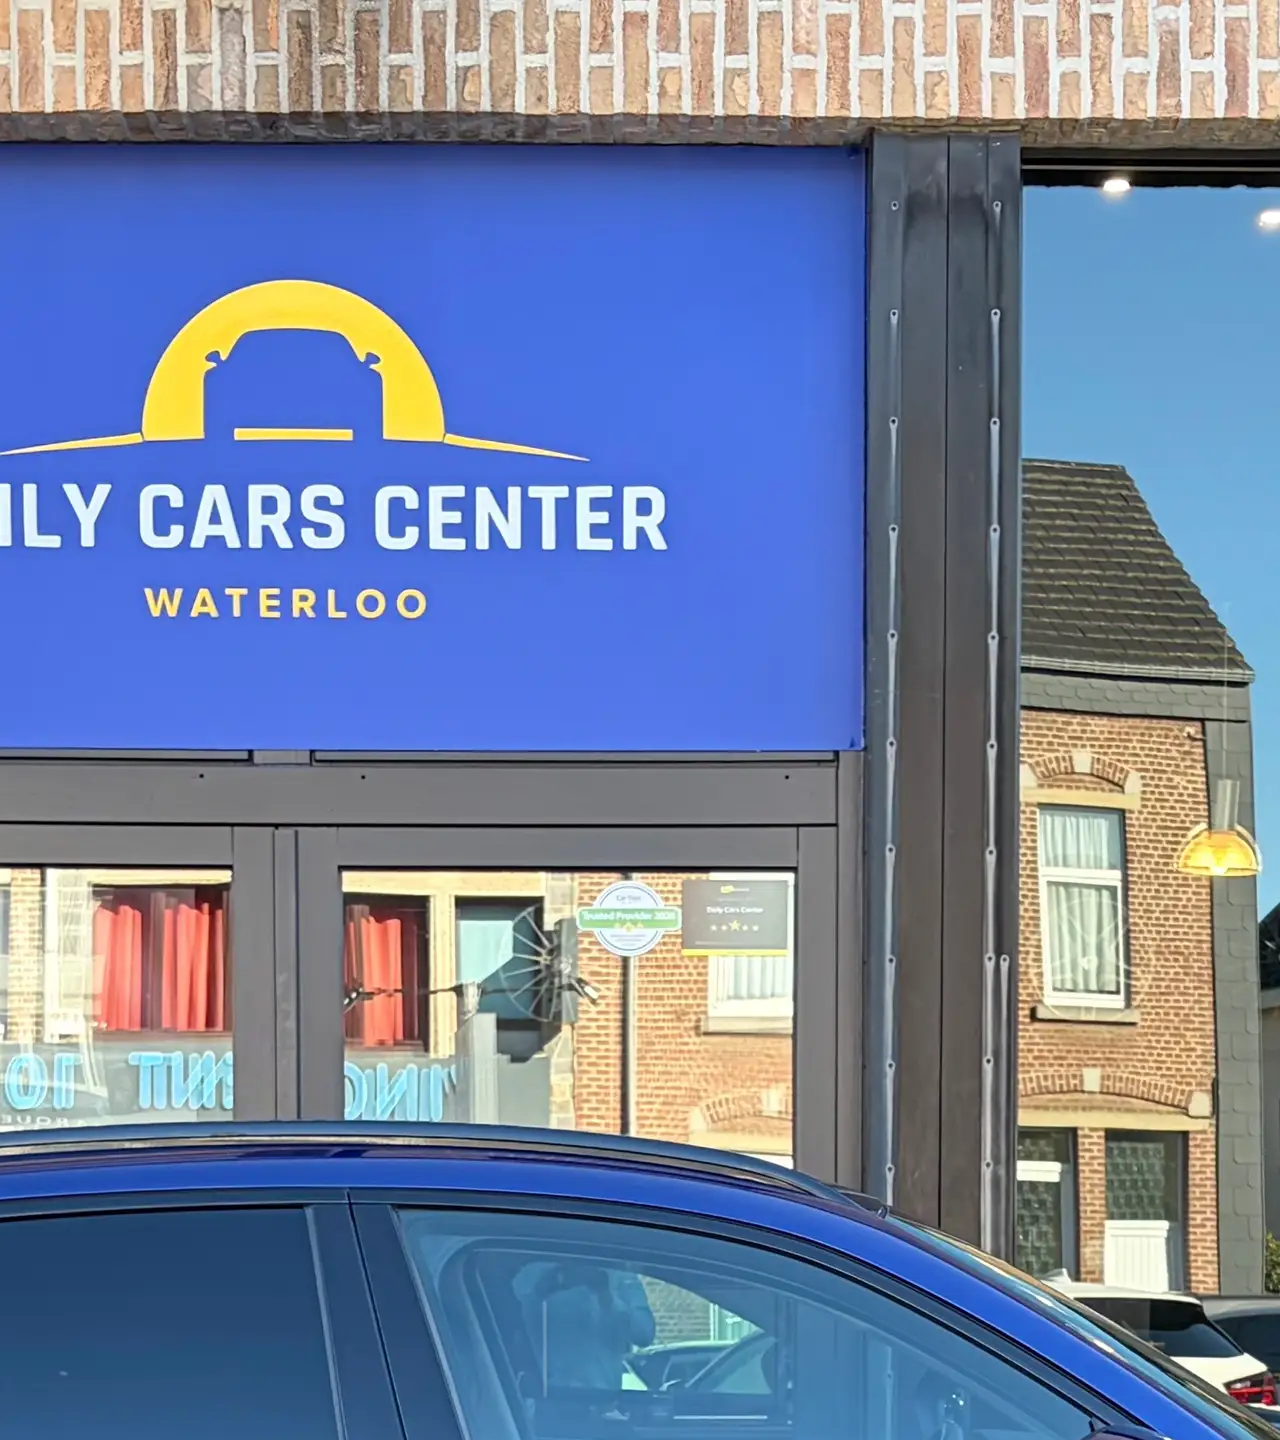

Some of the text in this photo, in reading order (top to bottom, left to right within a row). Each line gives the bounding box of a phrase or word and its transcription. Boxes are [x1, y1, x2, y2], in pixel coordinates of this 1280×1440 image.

[138, 483, 347, 550] CARS
[374, 484, 669, 551] CENTER
[143, 586, 430, 620] WATERLOO
[582, 911, 614, 921] Trusted
[616, 911, 652, 921] Provider
